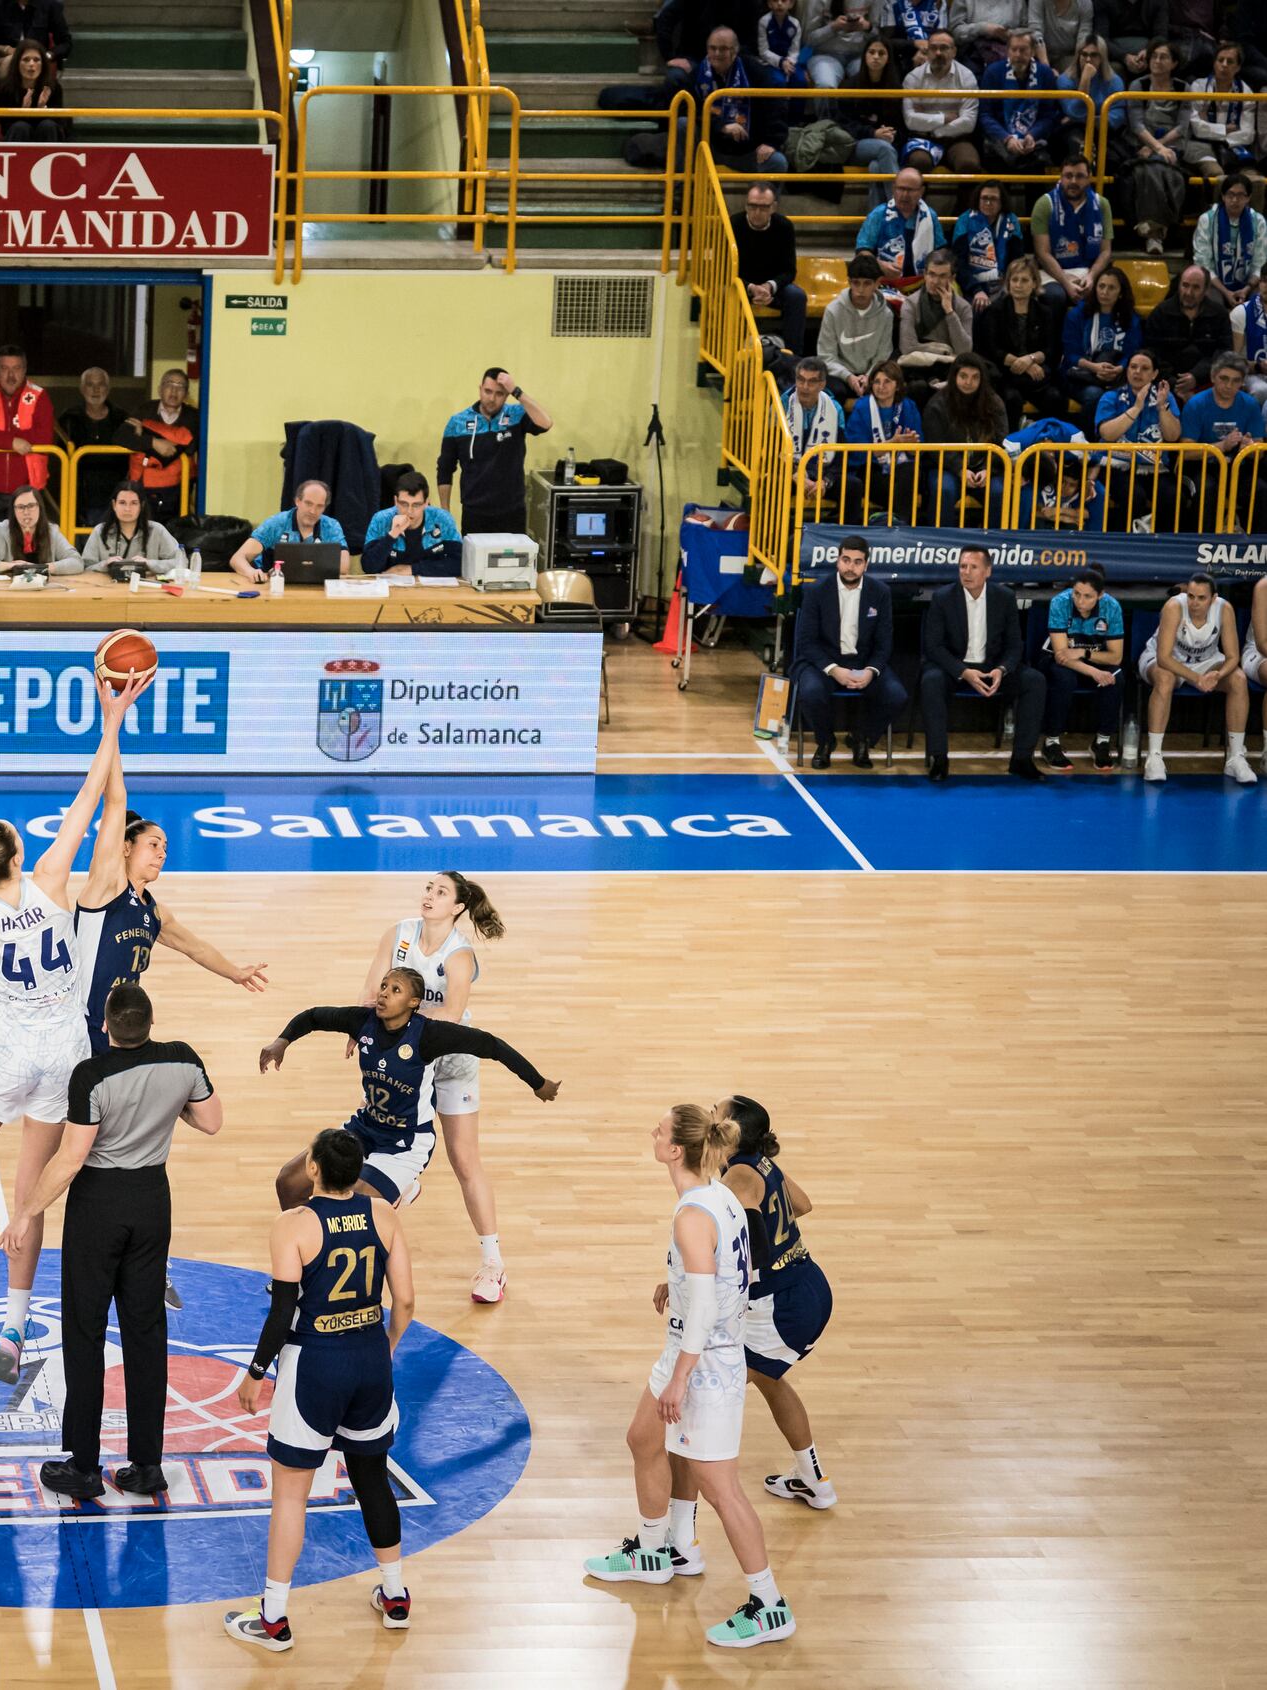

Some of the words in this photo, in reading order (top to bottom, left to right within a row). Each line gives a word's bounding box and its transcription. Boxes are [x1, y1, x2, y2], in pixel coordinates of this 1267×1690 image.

[247, 296, 283, 308] SALIDA
[390, 679, 519, 706] Diputación
[387, 728, 408, 744] de
[418, 723, 541, 744] Salamanca
[192, 806, 792, 839] Salamanca
[1, 926, 73, 991] 44
[131, 944, 150, 973] 13
[368, 1083, 391, 1112] 12
[326, 1217, 342, 1234] MC
[342, 1213, 368, 1232] BRIDE
[327, 1245, 376, 1302] 21
[320, 1310, 380, 1330] YÜKSELEN
